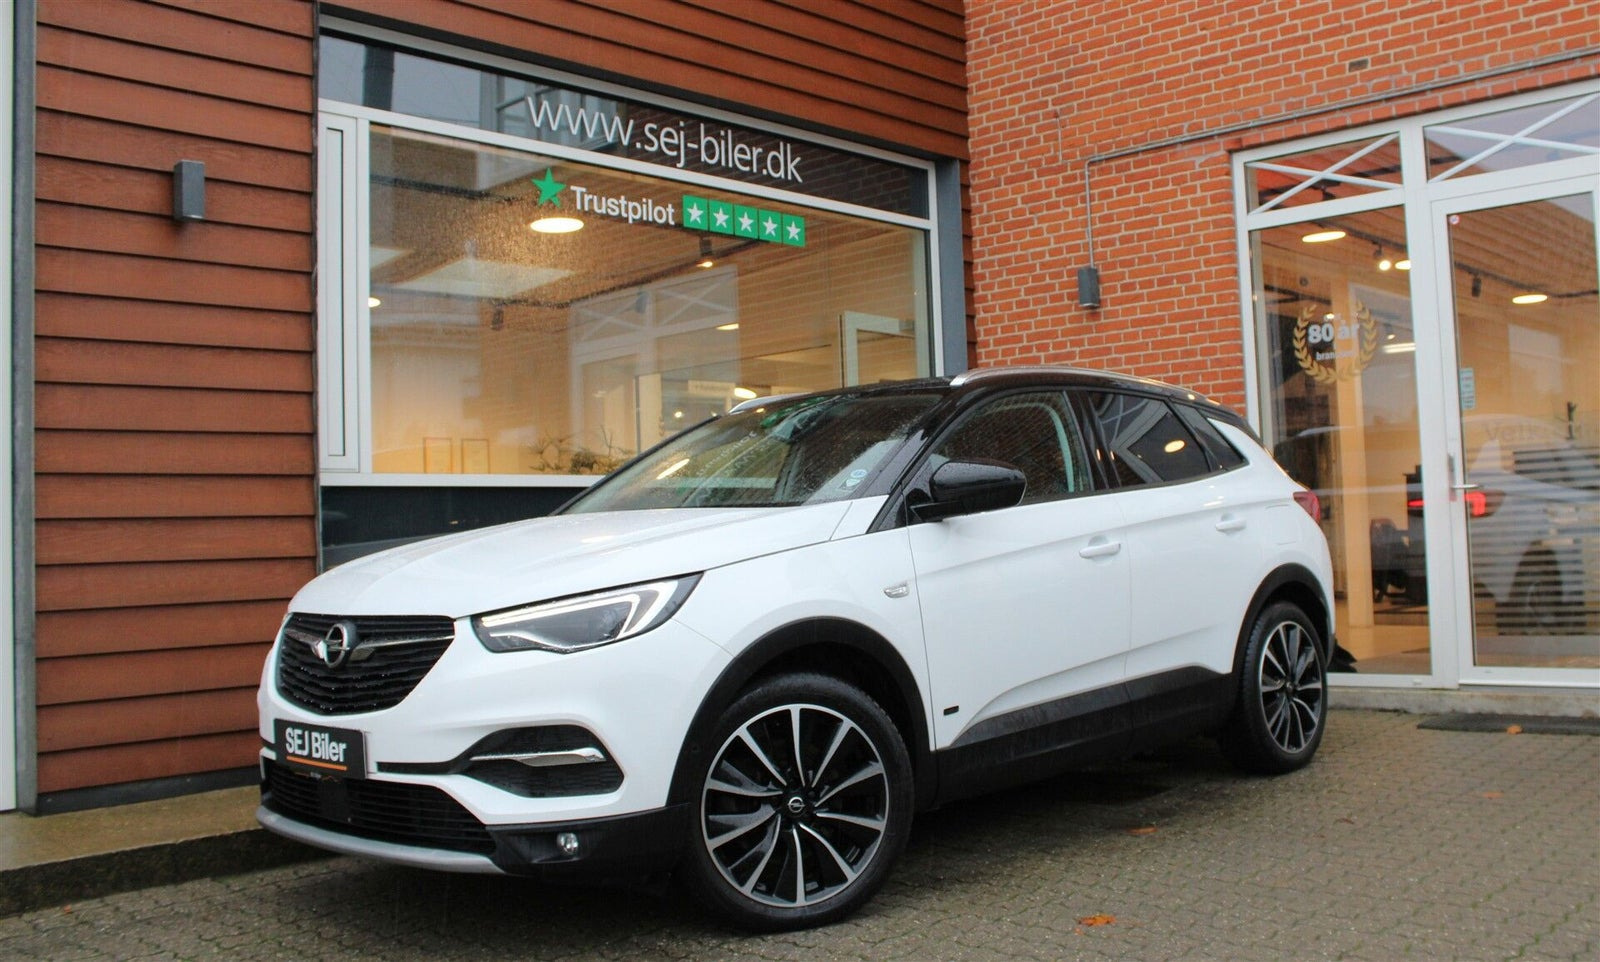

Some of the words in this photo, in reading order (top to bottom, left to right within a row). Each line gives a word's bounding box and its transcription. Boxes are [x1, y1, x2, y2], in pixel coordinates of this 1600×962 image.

[527, 96, 802, 183] www.sej-biler.dk
[570, 185, 676, 225] Trustpilot
[1307, 323, 1334, 344] 80
[285, 727, 309, 756] SEJ
[311, 732, 347, 762] Biler
